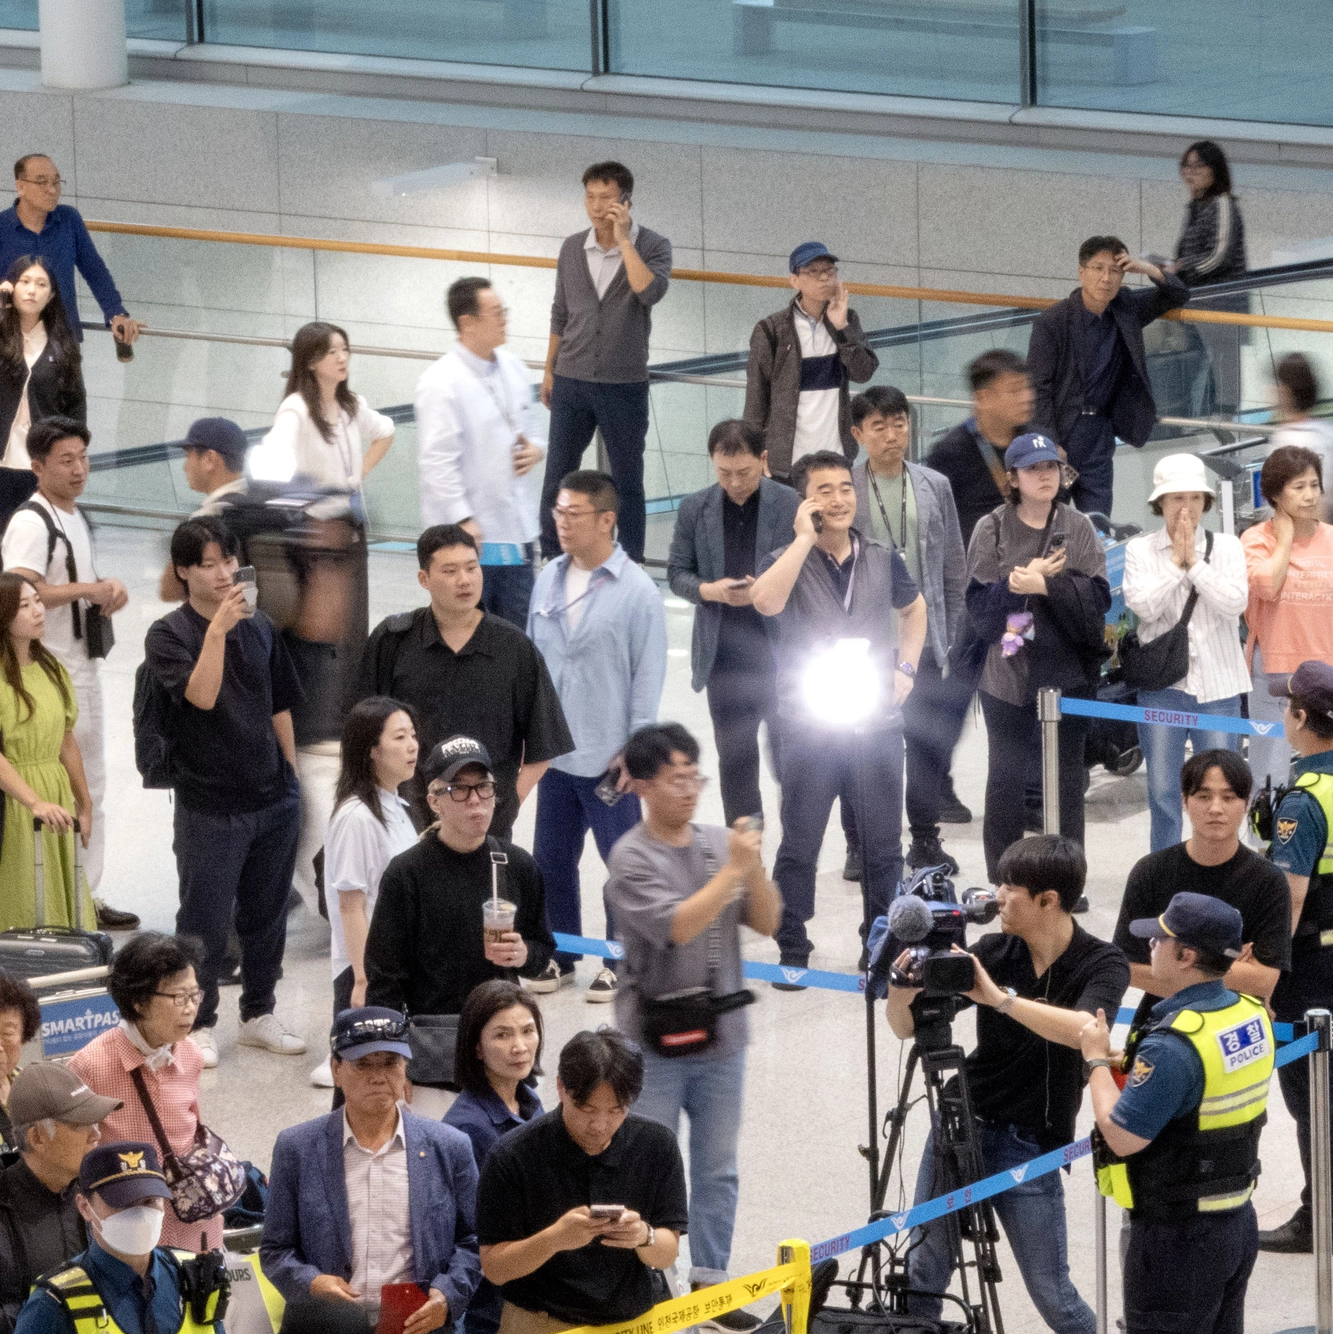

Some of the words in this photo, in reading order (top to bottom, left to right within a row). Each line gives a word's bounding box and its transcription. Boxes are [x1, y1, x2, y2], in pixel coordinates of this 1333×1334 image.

[1143, 710, 1199, 726] SECURITY
[41, 1009, 120, 1038] SMARTPAS
[1222, 1021, 1262, 1052] 경찰
[1230, 1043, 1265, 1067] POLICE
[1063, 1142, 1092, 1163] SECUR
[810, 1235, 851, 1261] SECURITY
[657, 1304, 700, 1330] 인천국제공항
[704, 1294, 733, 1315] 보안통제
